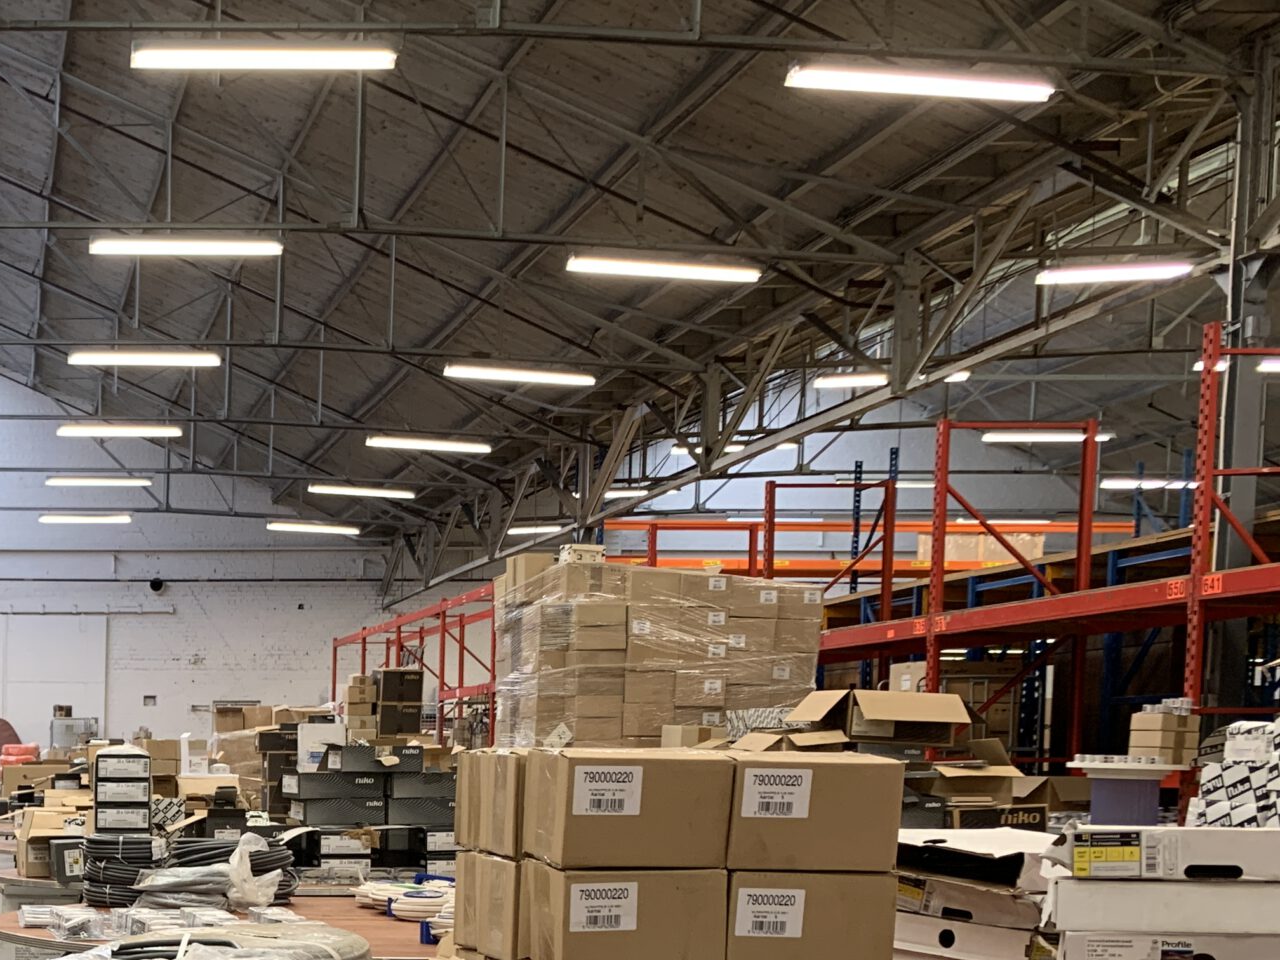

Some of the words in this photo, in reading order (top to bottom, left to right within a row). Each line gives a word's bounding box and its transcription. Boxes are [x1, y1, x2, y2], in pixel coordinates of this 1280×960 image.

[1203, 576, 1221, 593] 641
[355, 776, 375, 784] niko
[583, 771, 634, 783] 790000220
[753, 774, 803, 787] 790000220
[1000, 811, 1041, 825] niko
[579, 887, 629, 901] 790000220
[746, 893, 796, 906] 790000220
[1161, 940, 1192, 949] Profile
